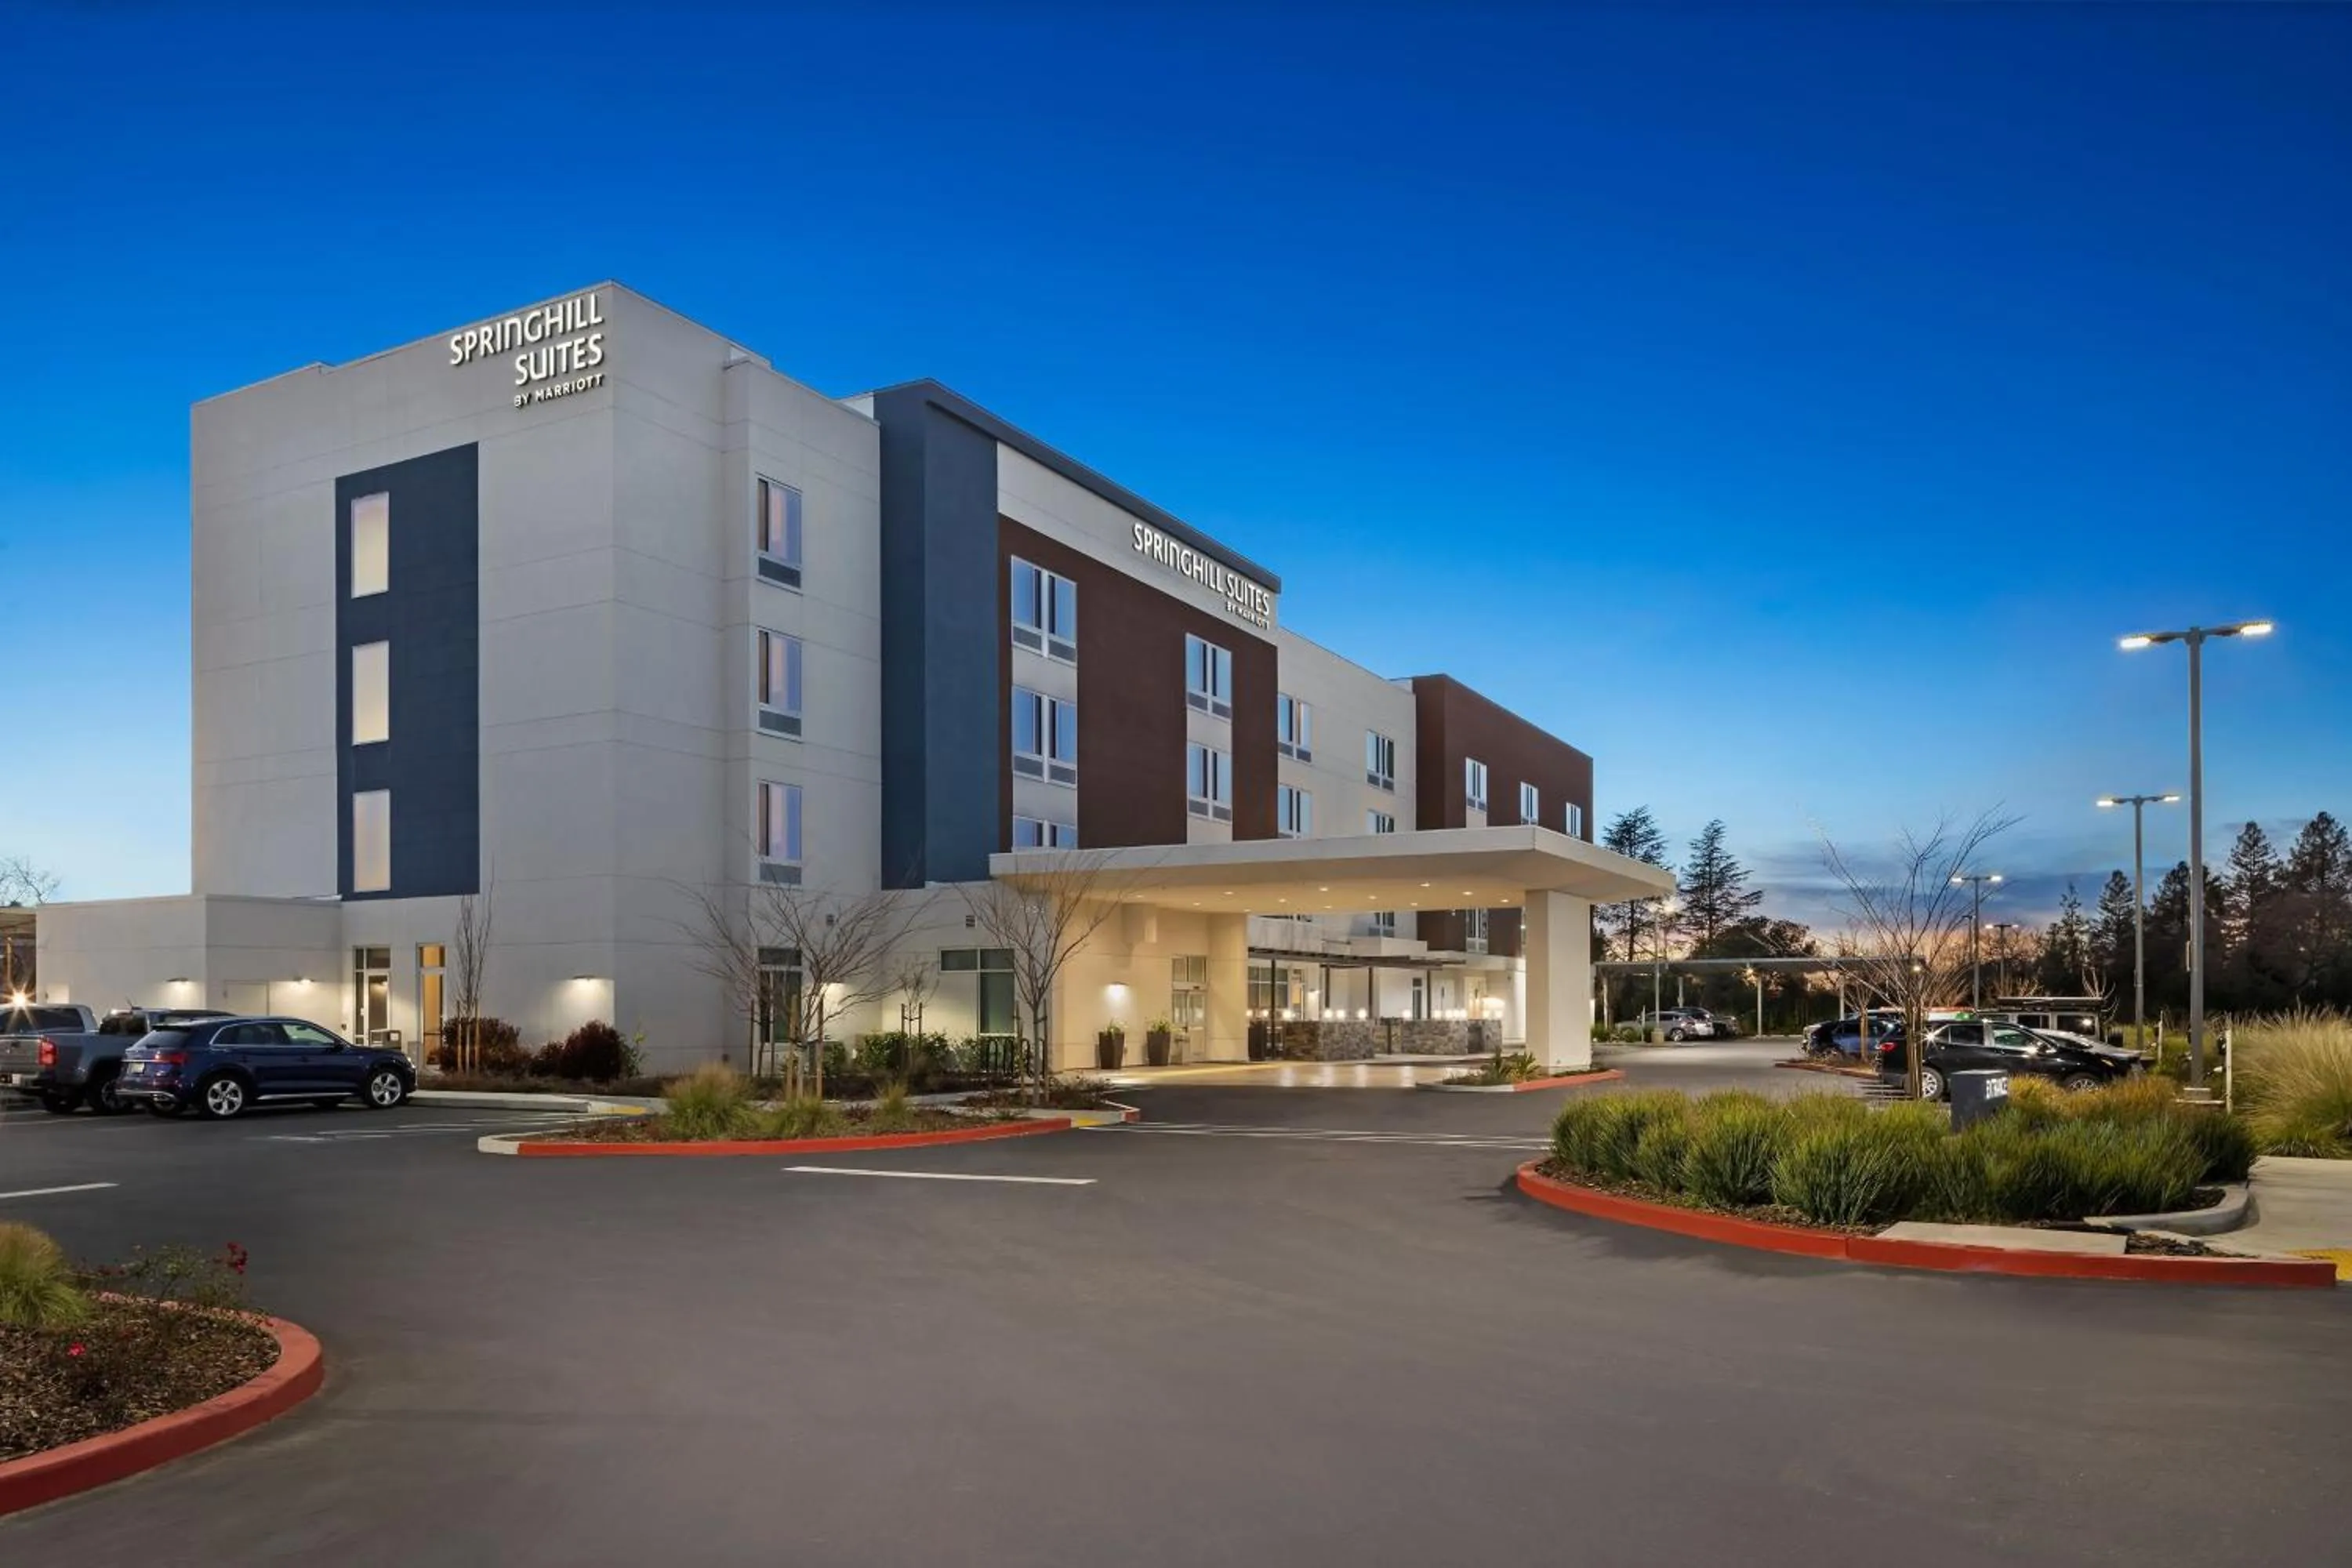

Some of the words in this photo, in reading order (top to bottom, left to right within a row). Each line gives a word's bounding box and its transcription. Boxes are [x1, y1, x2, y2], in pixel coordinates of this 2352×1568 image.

[449, 293, 604, 366] SPRINGHILL
[514, 333, 604, 386] SUITES
[514, 393, 530, 407] BY
[535, 373, 604, 402] MARRIOTT
[1133, 523, 1224, 593] SPRINGHILL
[1225, 573, 1269, 616] SUITES
